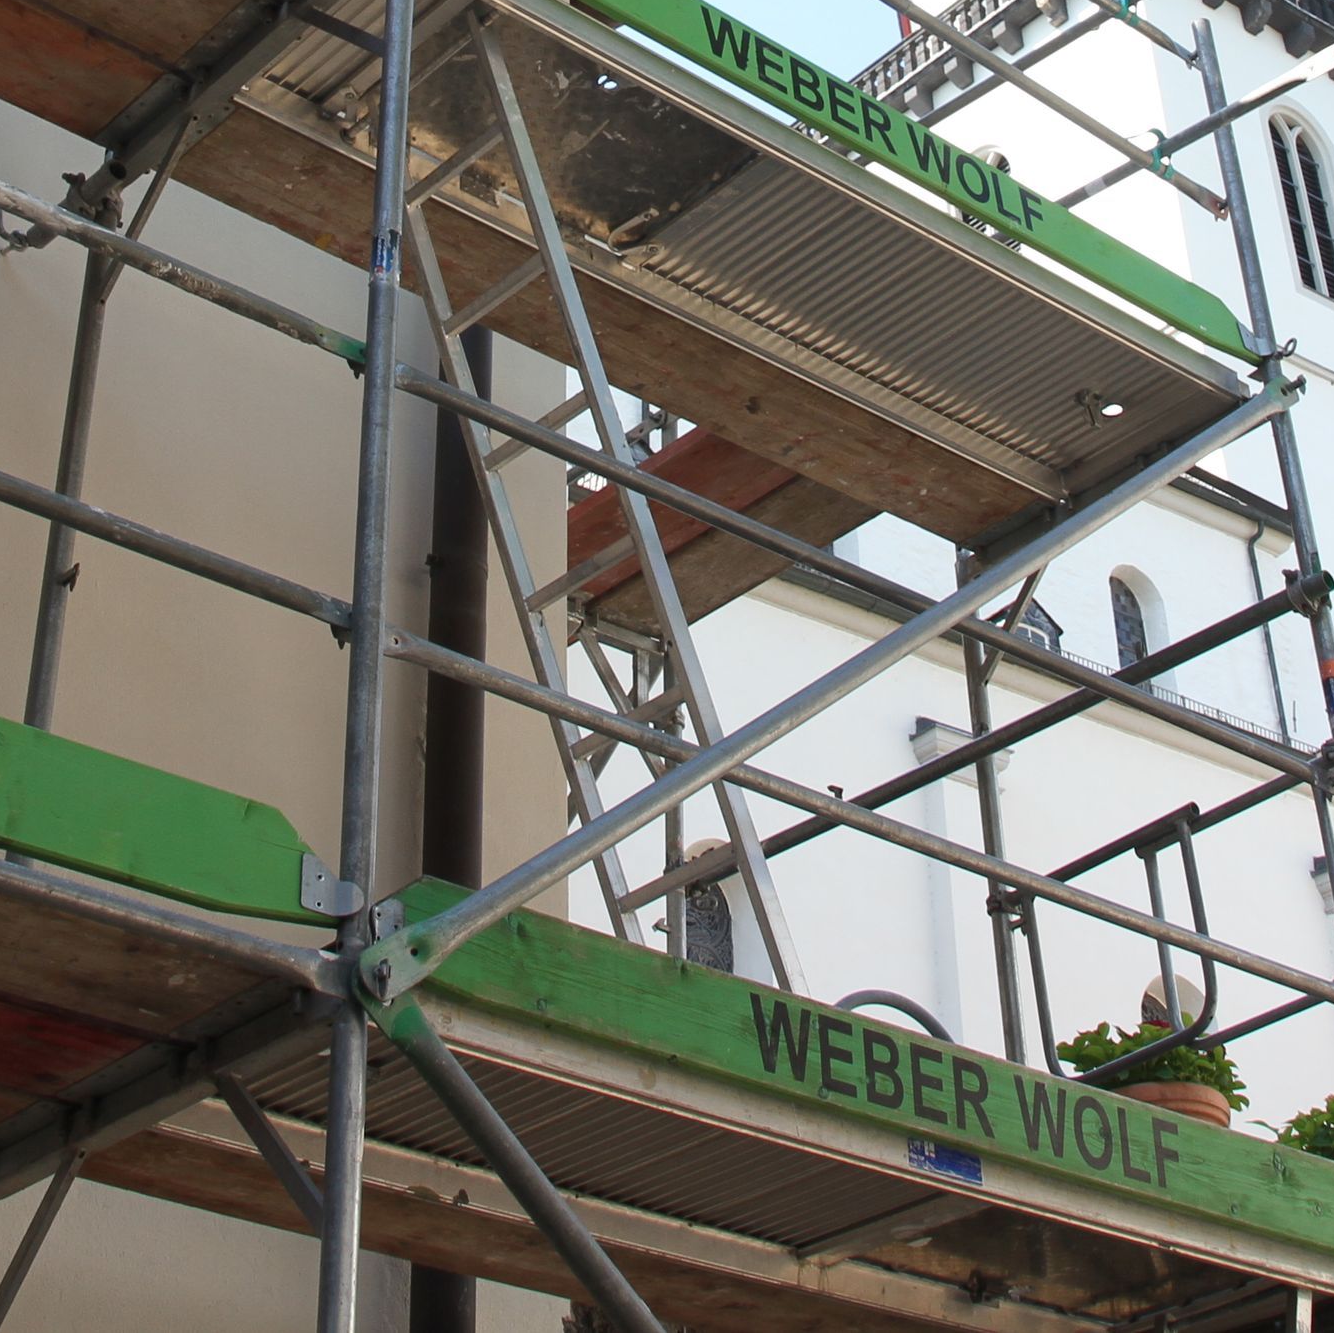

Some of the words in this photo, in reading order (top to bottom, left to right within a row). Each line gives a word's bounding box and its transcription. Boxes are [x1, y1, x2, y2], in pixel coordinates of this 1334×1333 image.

[700, 6, 899, 156] WEBER
[906, 120, 1043, 232] WOLF
[749, 991, 995, 1139] WEBER
[1014, 1074, 1180, 1188] WOLF
